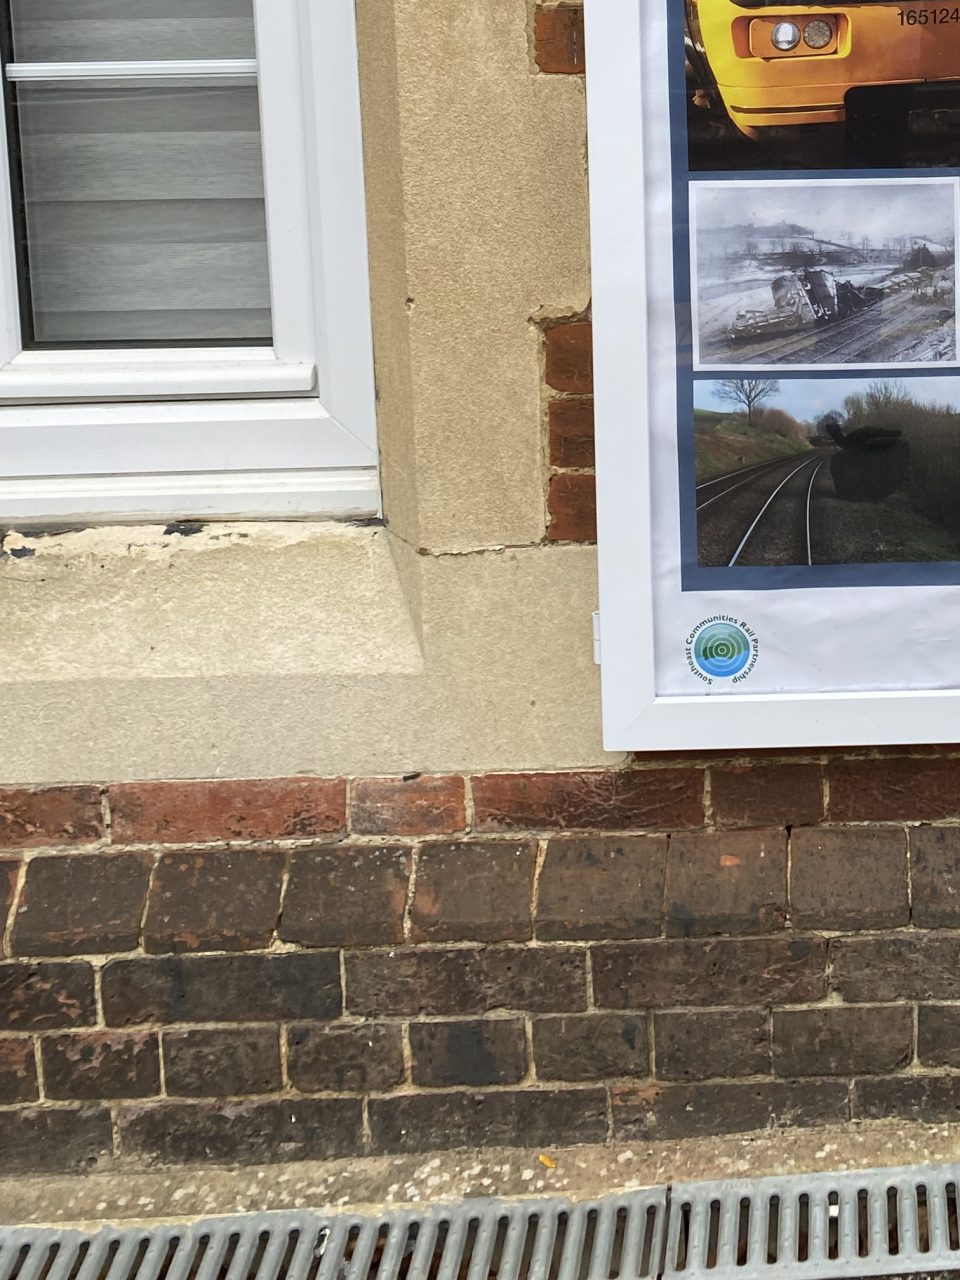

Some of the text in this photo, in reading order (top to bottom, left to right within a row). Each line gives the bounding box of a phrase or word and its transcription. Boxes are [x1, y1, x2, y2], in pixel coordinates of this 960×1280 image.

[897, 8, 960, 26] 165124
[685, 614, 759, 685] Southeast Communities Rail Partnership
